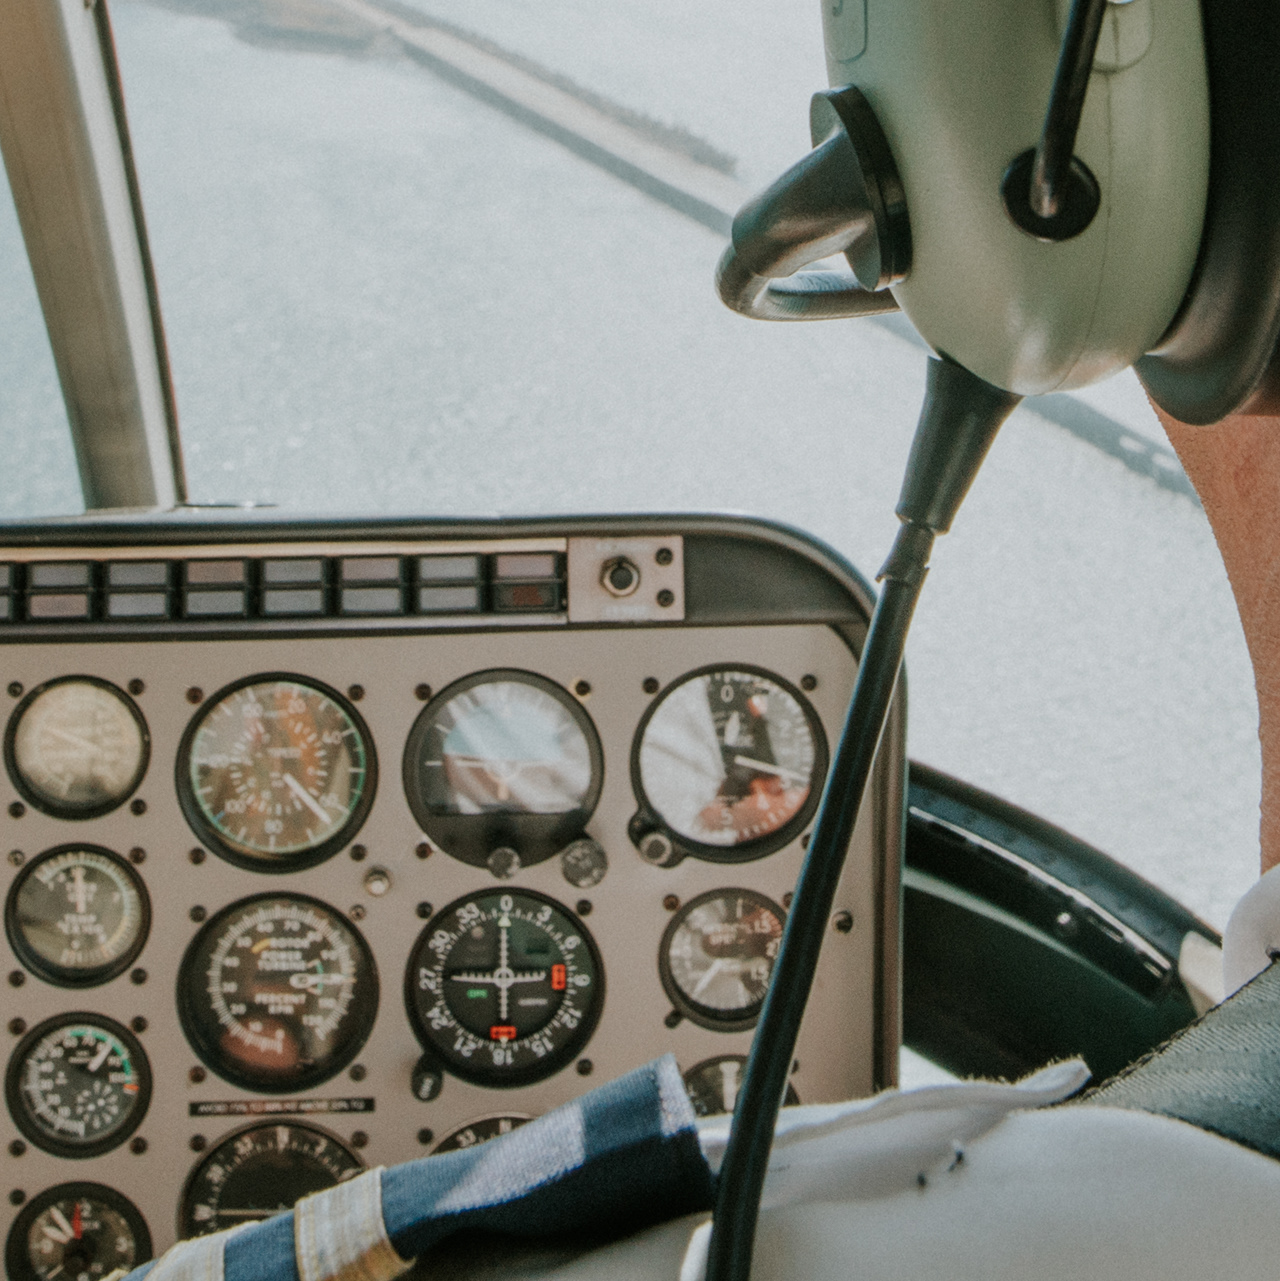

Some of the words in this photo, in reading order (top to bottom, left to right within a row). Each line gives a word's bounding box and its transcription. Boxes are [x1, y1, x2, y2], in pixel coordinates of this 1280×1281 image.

[720, 684, 734, 703] 0
[500, 894, 513, 911] 0
[456, 902, 480, 923] 33
[537, 905, 553, 921] 3
[428, 930, 451, 953] 30
[564, 935, 581, 950] 6
[419, 968, 437, 990] 27
[492, 1048, 515, 1066] 18
